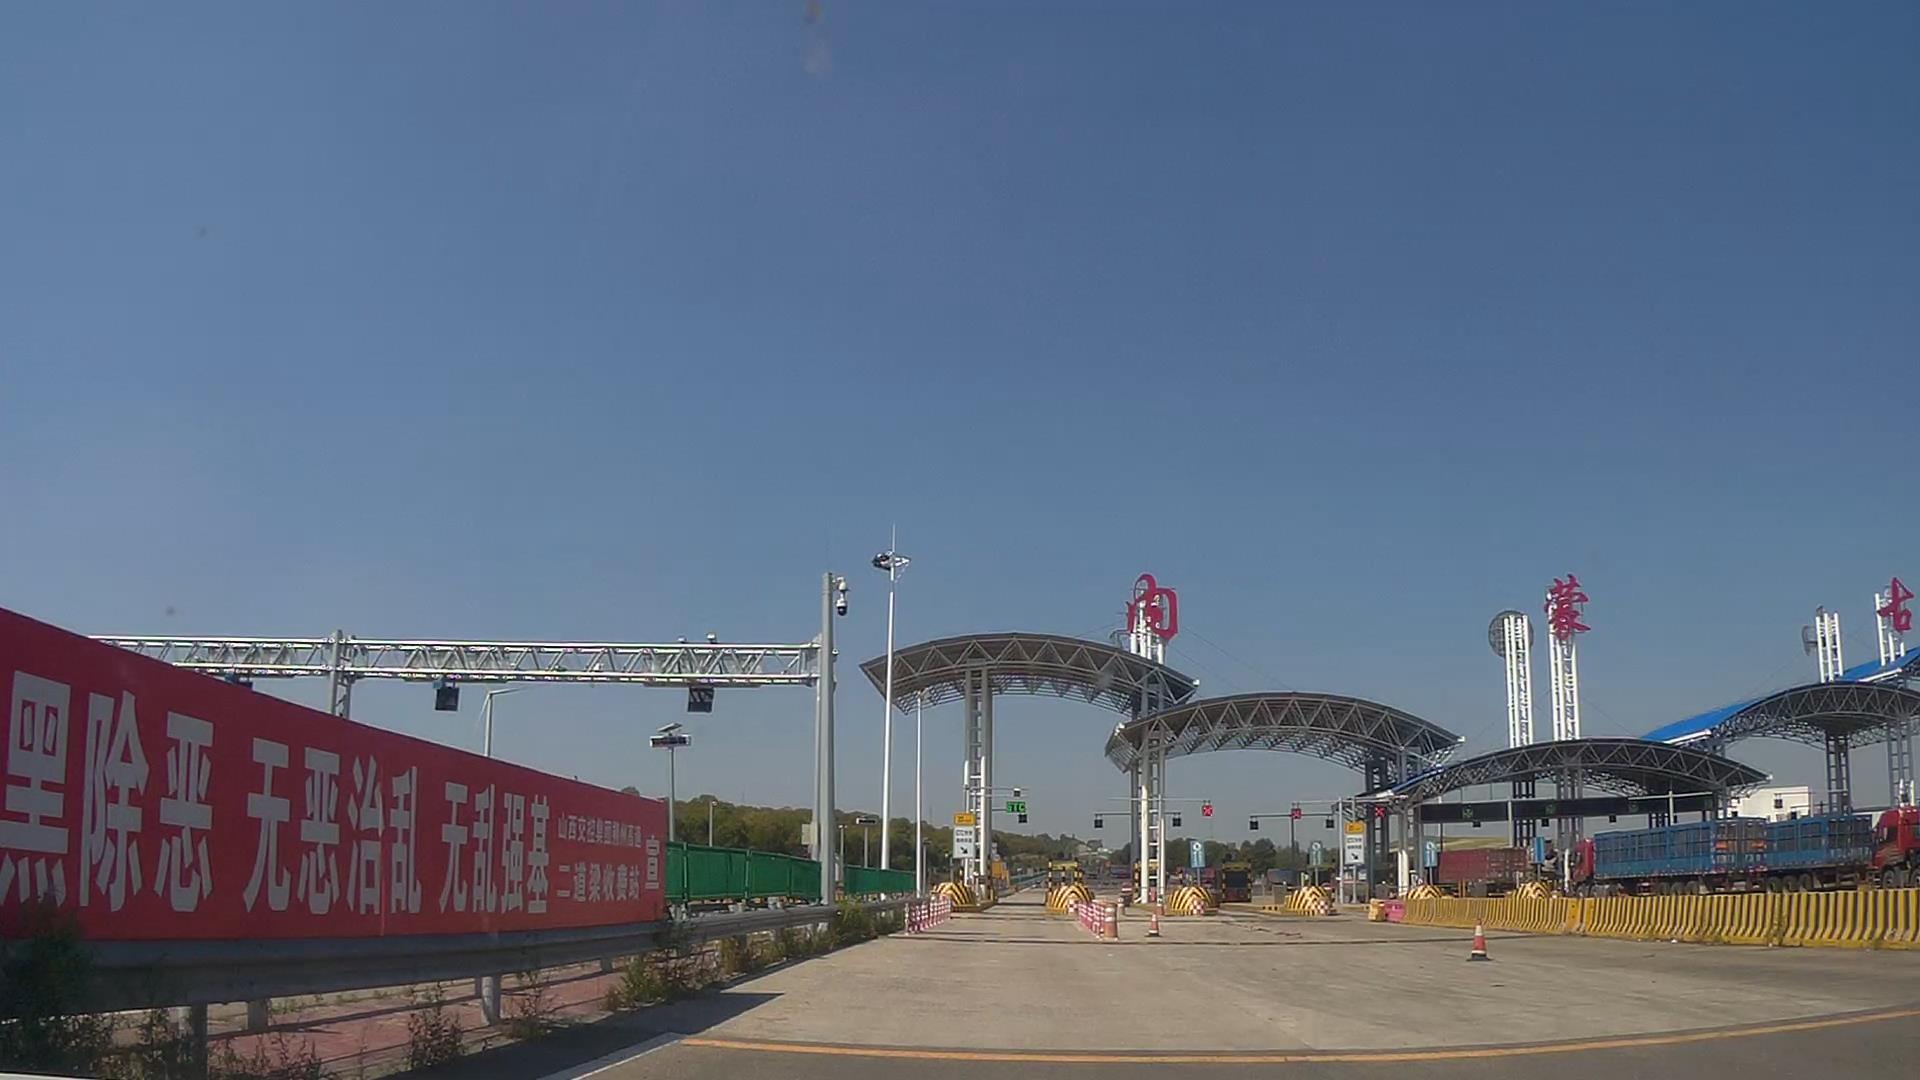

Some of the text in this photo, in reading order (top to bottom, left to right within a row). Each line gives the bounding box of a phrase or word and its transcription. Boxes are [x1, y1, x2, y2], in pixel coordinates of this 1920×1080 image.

[1544, 574, 1591, 640] 蒙
[1877, 577, 1914, 632] 古
[0, 670, 549, 915] 黑除恶 无恶治乱 无乱强基
[557, 862, 640, 902] 二道梁收费站
[645, 834, 660, 889] 宣
